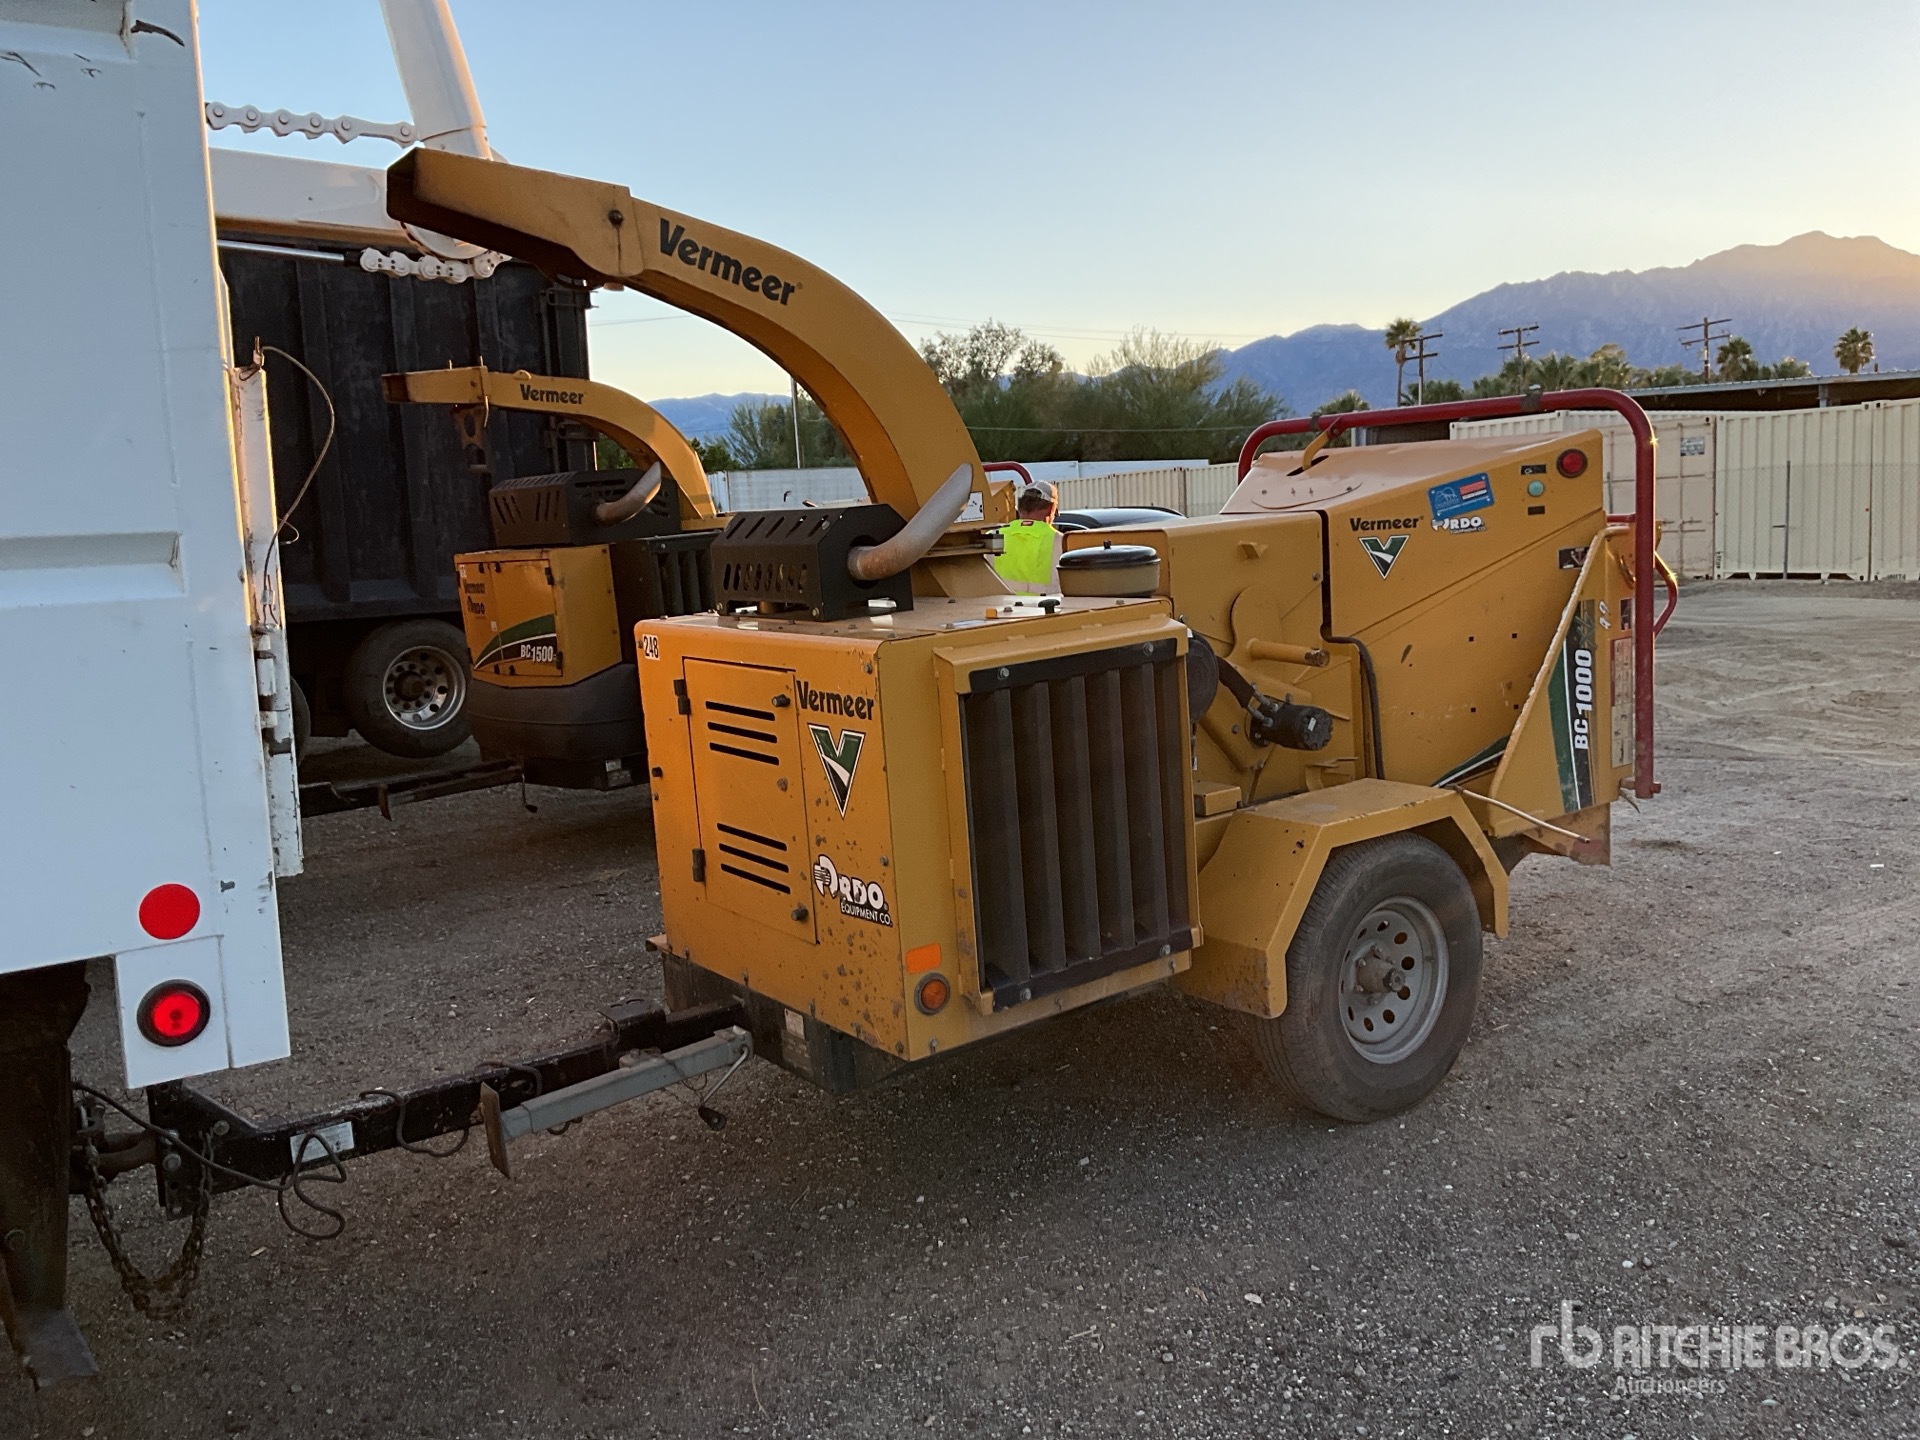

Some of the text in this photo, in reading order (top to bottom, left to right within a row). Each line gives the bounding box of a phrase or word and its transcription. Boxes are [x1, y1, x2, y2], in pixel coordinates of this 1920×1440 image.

[660, 218, 796, 306] Vermeer
[520, 384, 584, 405] Vermeer
[1350, 517, 1420, 531] Vermeer
[644, 635, 659, 658] 248
[796, 680, 875, 720] Vermeer
[841, 902, 878, 922] EQUIPMENT
